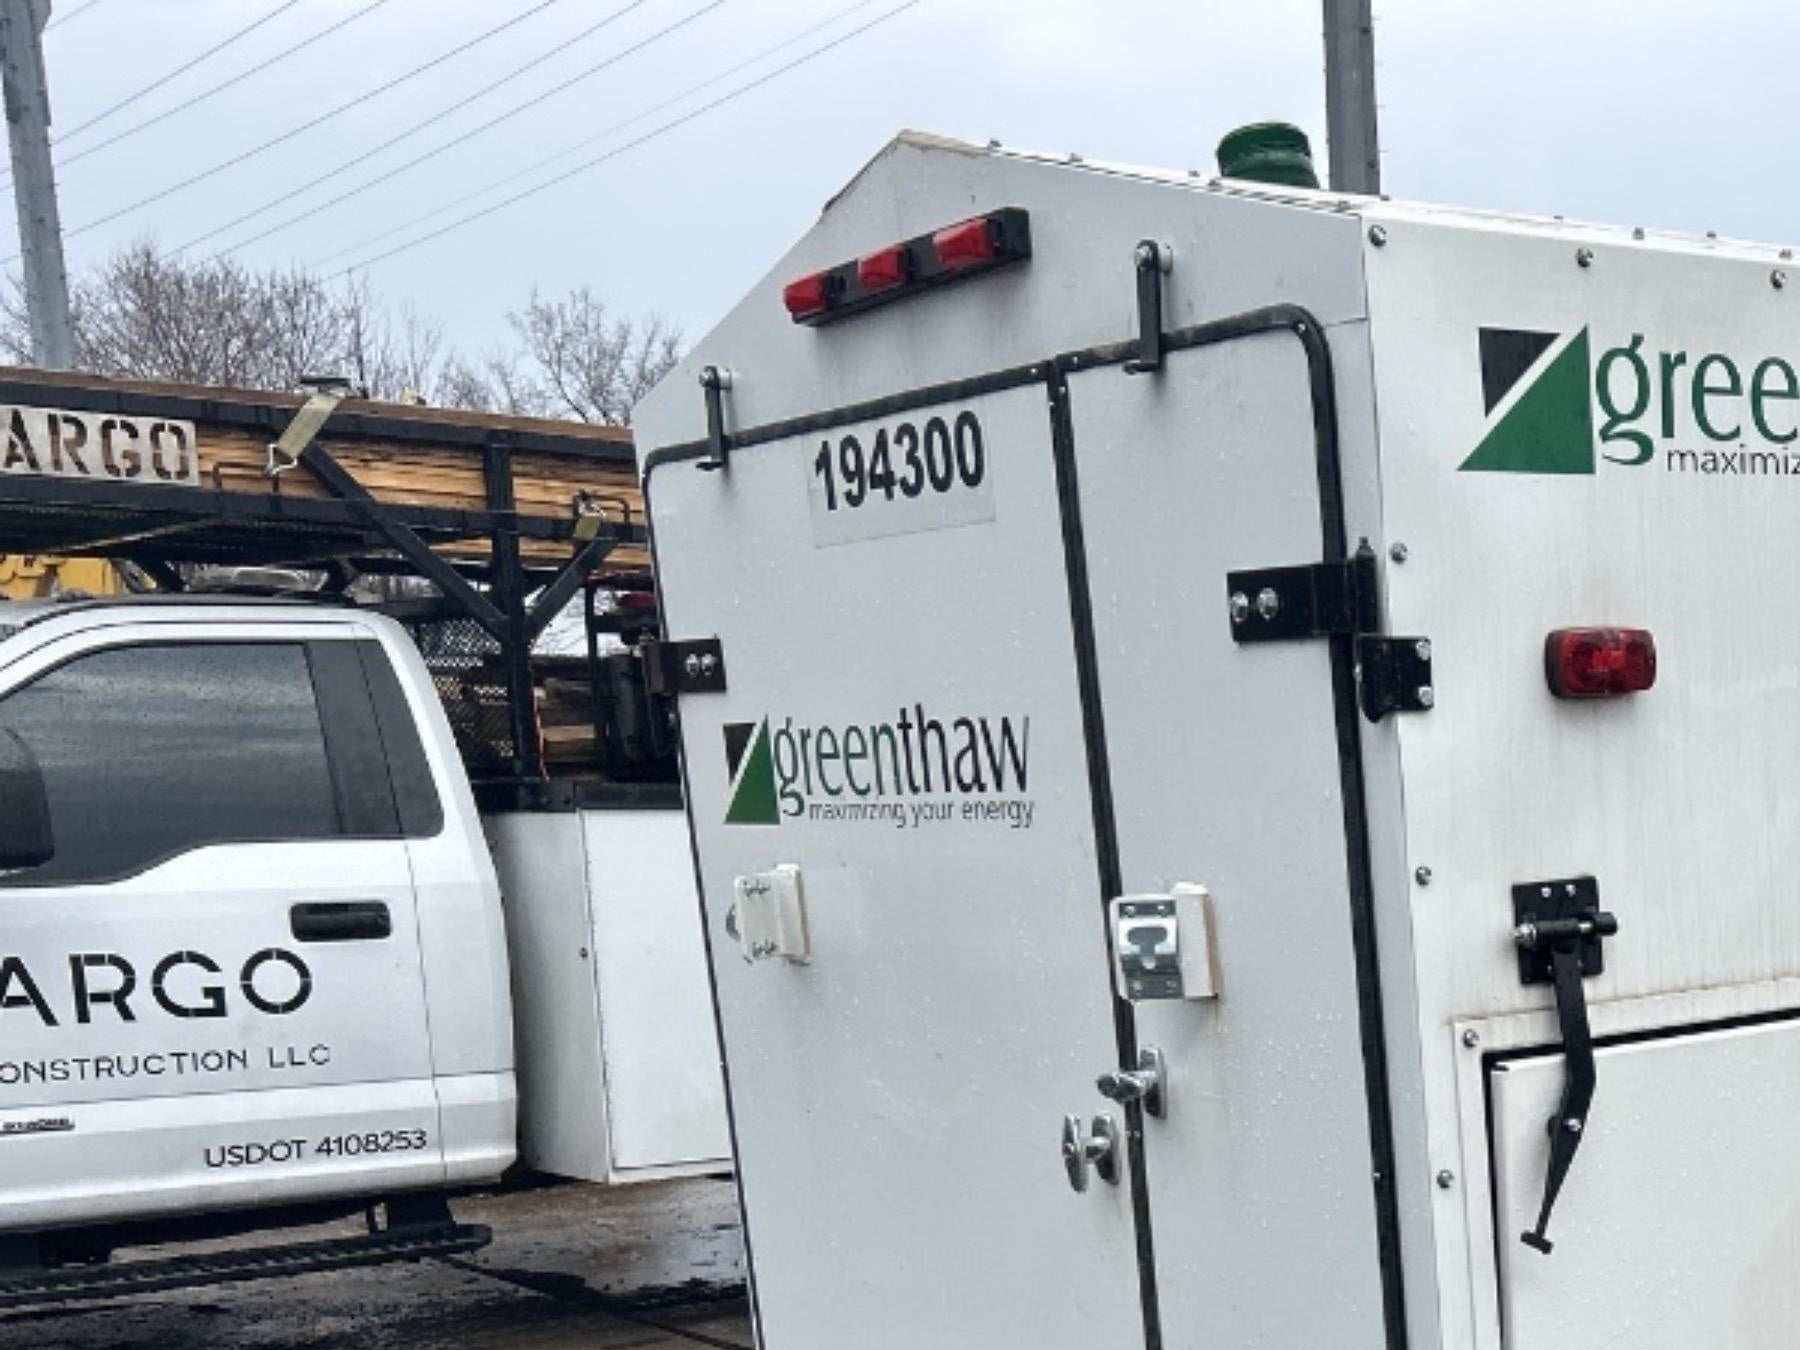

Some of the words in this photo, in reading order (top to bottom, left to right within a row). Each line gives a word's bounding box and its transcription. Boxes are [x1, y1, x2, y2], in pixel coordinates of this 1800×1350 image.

[3, 408, 190, 480] ARGO
[814, 410, 985, 511] 194300
[773, 702, 1030, 817] greenthaw
[809, 801, 907, 829] maximizing
[911, 801, 955, 829] your
[962, 799, 1036, 829] energy
[0, 947, 313, 1027] ARGO
[268, 1043, 330, 1068] LLC
[204, 1139, 307, 1168] USDOT
[315, 1129, 428, 1158] 4108253
